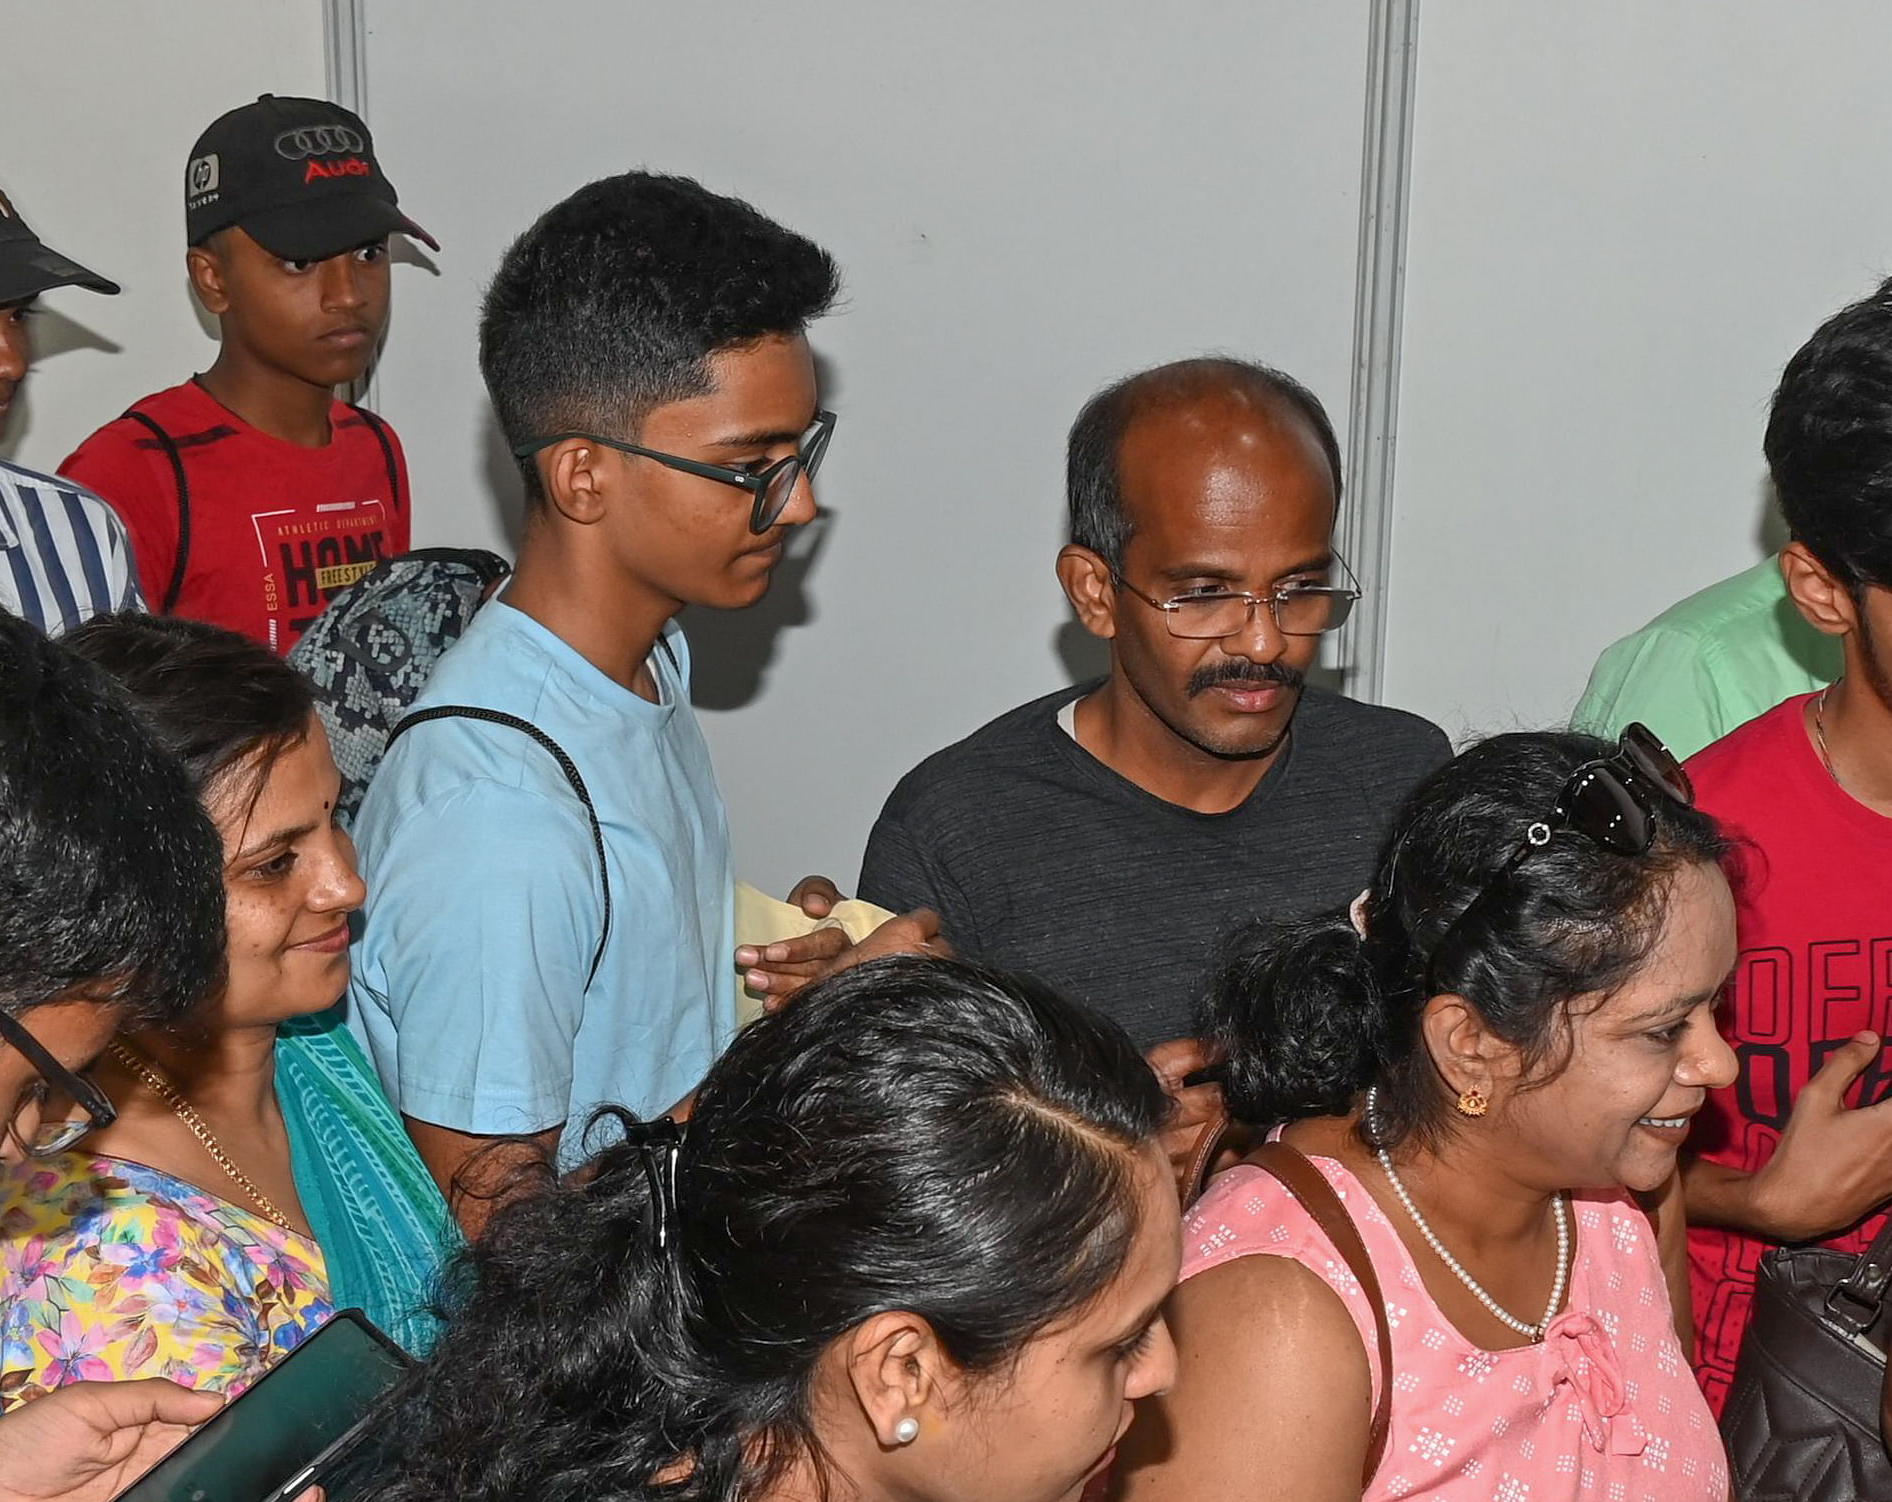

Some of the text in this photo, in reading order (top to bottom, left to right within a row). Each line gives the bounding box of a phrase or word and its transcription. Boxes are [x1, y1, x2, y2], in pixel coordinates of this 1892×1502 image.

[305, 159, 370, 185] Audi
[278, 521, 328, 536] ATHLETIC
[264, 573, 278, 611] ESSA
